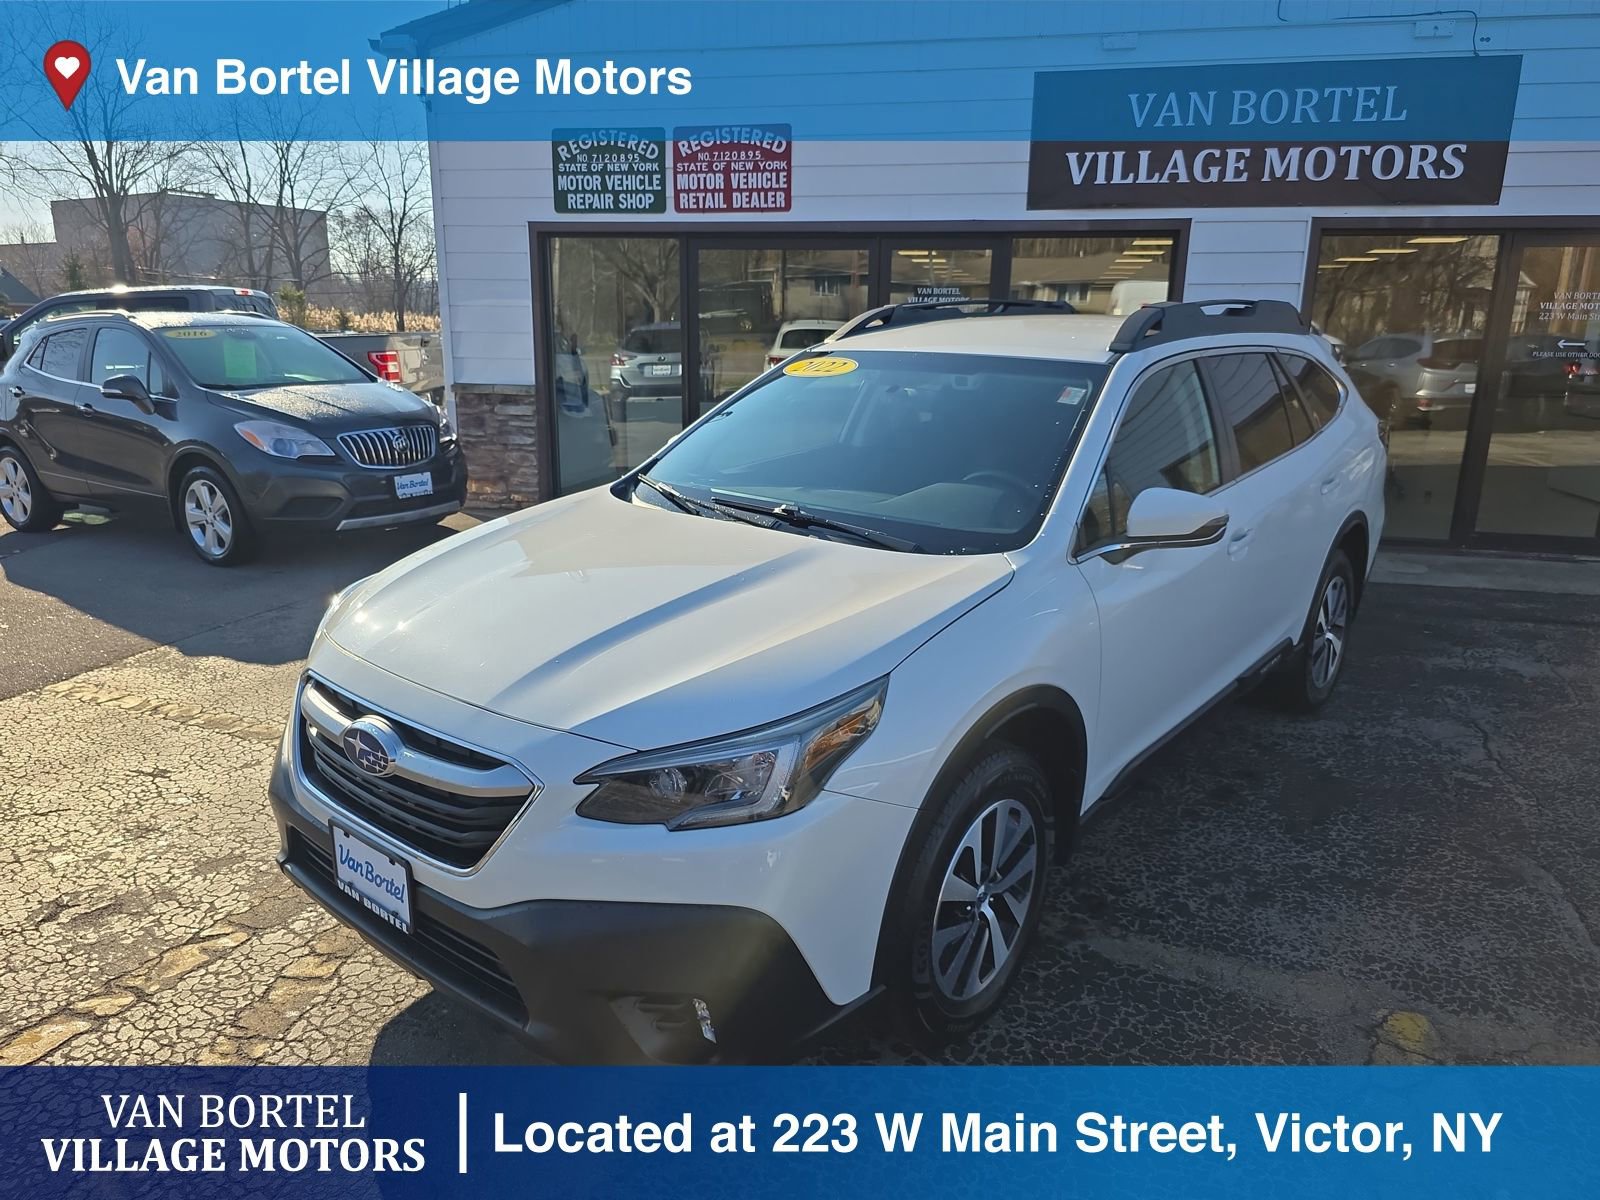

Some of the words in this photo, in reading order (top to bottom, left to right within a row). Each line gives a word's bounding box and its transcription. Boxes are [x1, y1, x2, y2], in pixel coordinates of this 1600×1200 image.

[1128, 91, 1216, 128] VAN
[1229, 86, 1408, 126] BORTEL
[557, 129, 659, 161] REGISTERED
[678, 127, 787, 157] REGISTERED
[592, 153, 640, 163] 7120895
[713, 150, 762, 160] 7120895
[558, 163, 588, 172] STATE
[591, 163, 604, 172] OF
[607, 163, 629, 172] NEW
[632, 162, 660, 172] YORK
[676, 162, 709, 172] STATE
[712, 162, 727, 171] OF
[731, 161, 754, 171] NEW
[758, 160, 788, 170] YORK
[1065, 148, 1249, 185] VILLAGE
[1260, 143, 1467, 182] MOTORS
[557, 175, 602, 191] MOTOR
[605, 174, 662, 191] VEHICLE
[676, 173, 724, 190] MOTOR
[730, 172, 788, 189] VEHICLE
[567, 193, 614, 209] REPAIR
[618, 193, 655, 209] SHOP
[680, 192, 727, 209] RETAIL
[732, 191, 786, 209] DEALER
[917, 287, 932, 295] VAN
[933, 287, 961, 295] BORTEL
[1554, 292, 1572, 300] VAN
[907, 296, 937, 304] VILLAGE
[1540, 301, 1578, 310] VILLAGE
[1539, 312, 1554, 320] 223
[1556, 312, 1566, 320] W
[1567, 312, 1588, 320] Main
[792, 361, 848, 373] 2022
[338, 880, 360, 902] VAN
[363, 897, 409, 935] BORTEL
